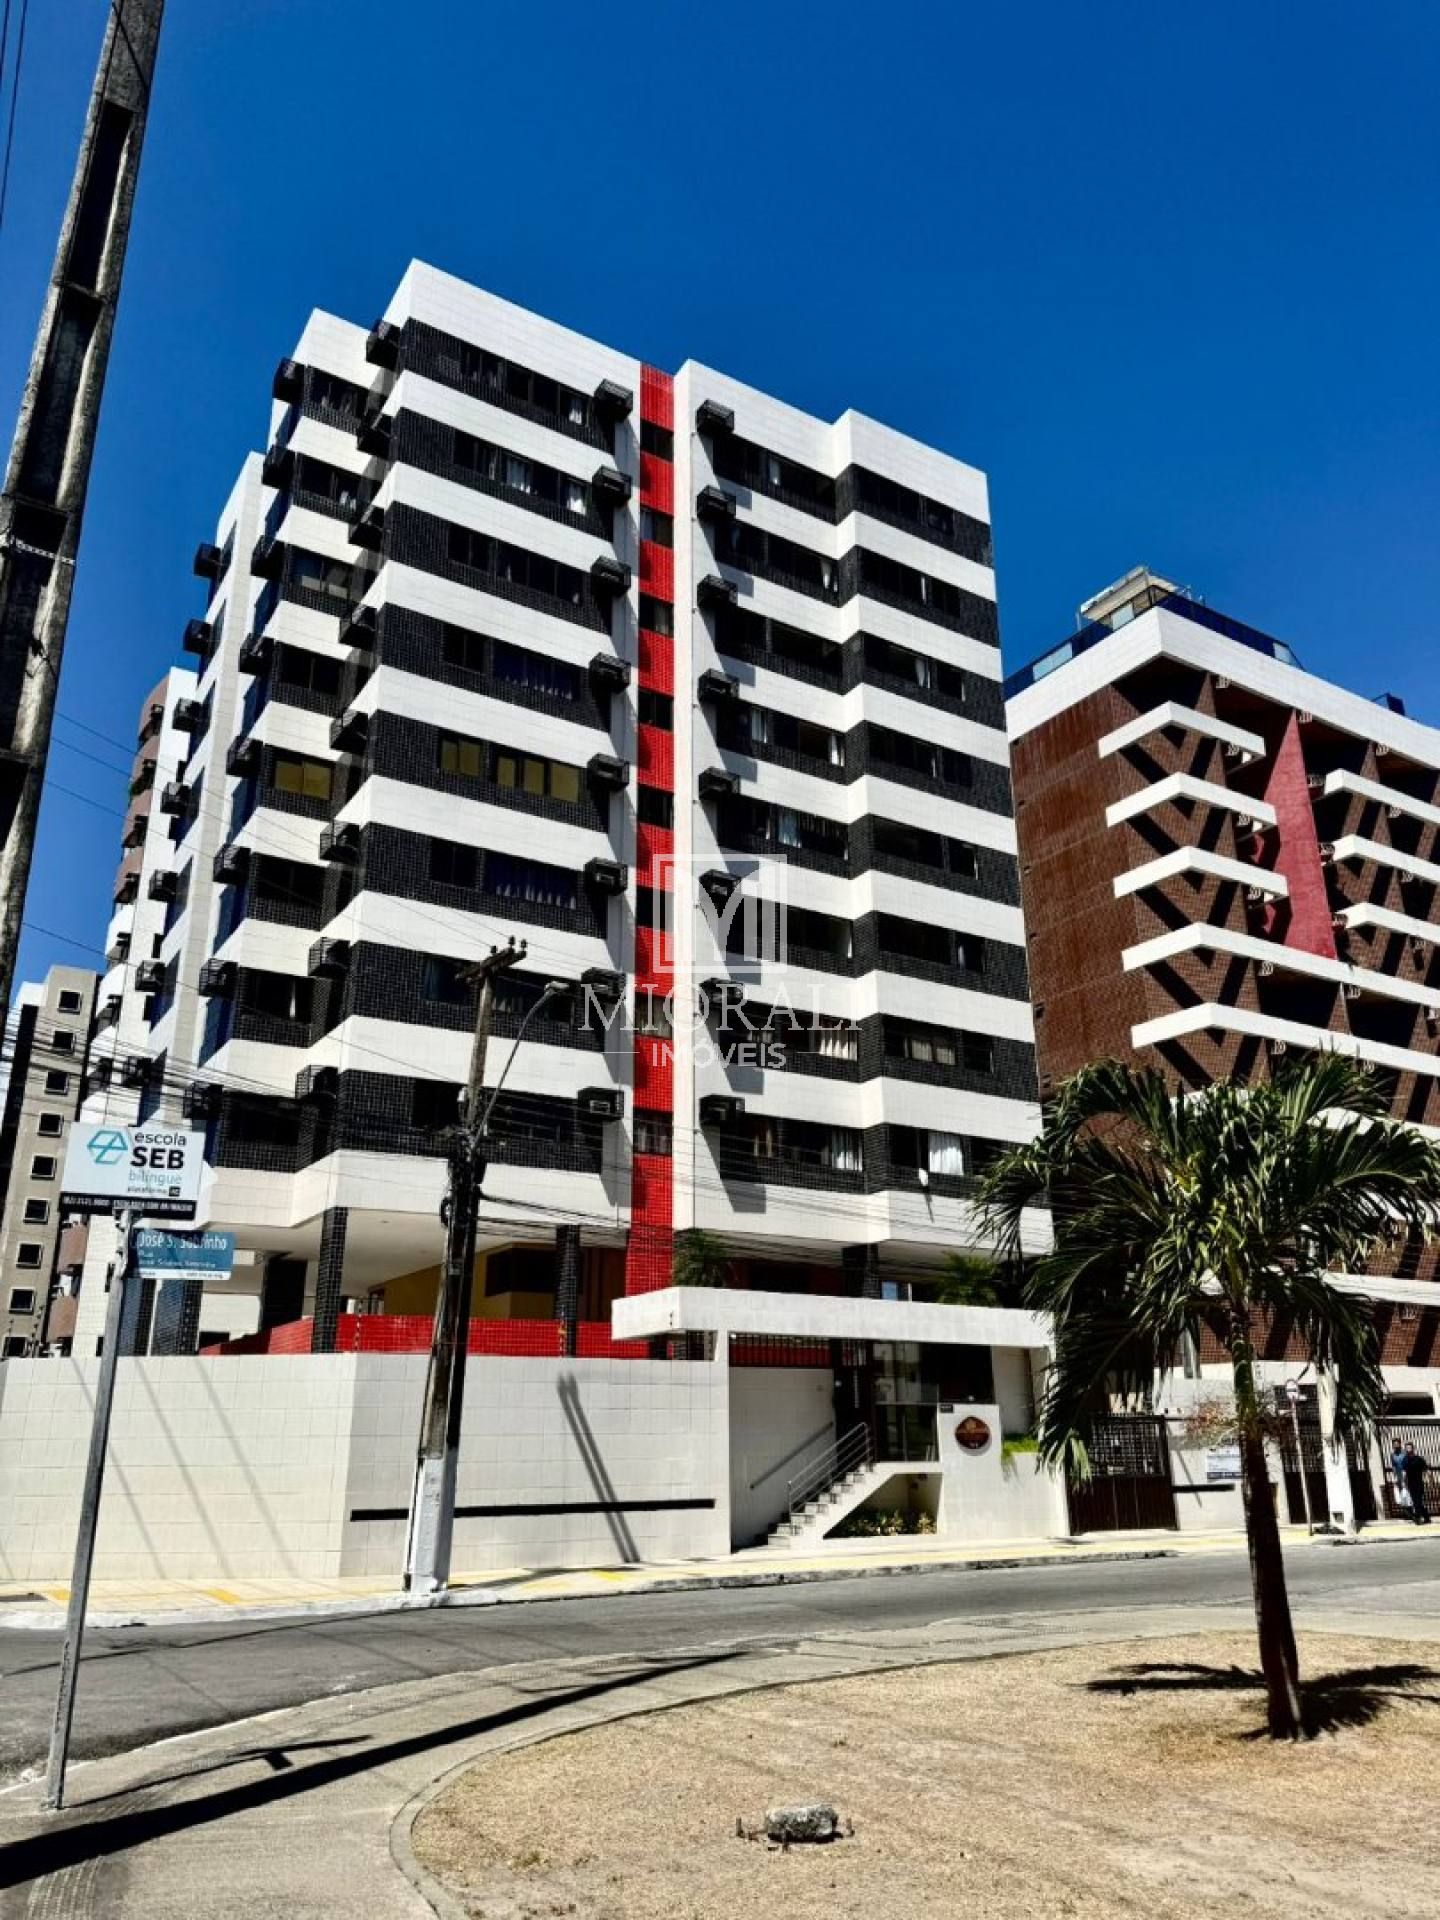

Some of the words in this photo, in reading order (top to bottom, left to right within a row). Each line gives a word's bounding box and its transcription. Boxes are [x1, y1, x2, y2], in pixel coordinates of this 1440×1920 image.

[134, 1131, 187, 1146] escola
[130, 1146, 185, 1170] SEB
[138, 1230, 166, 1248] José
